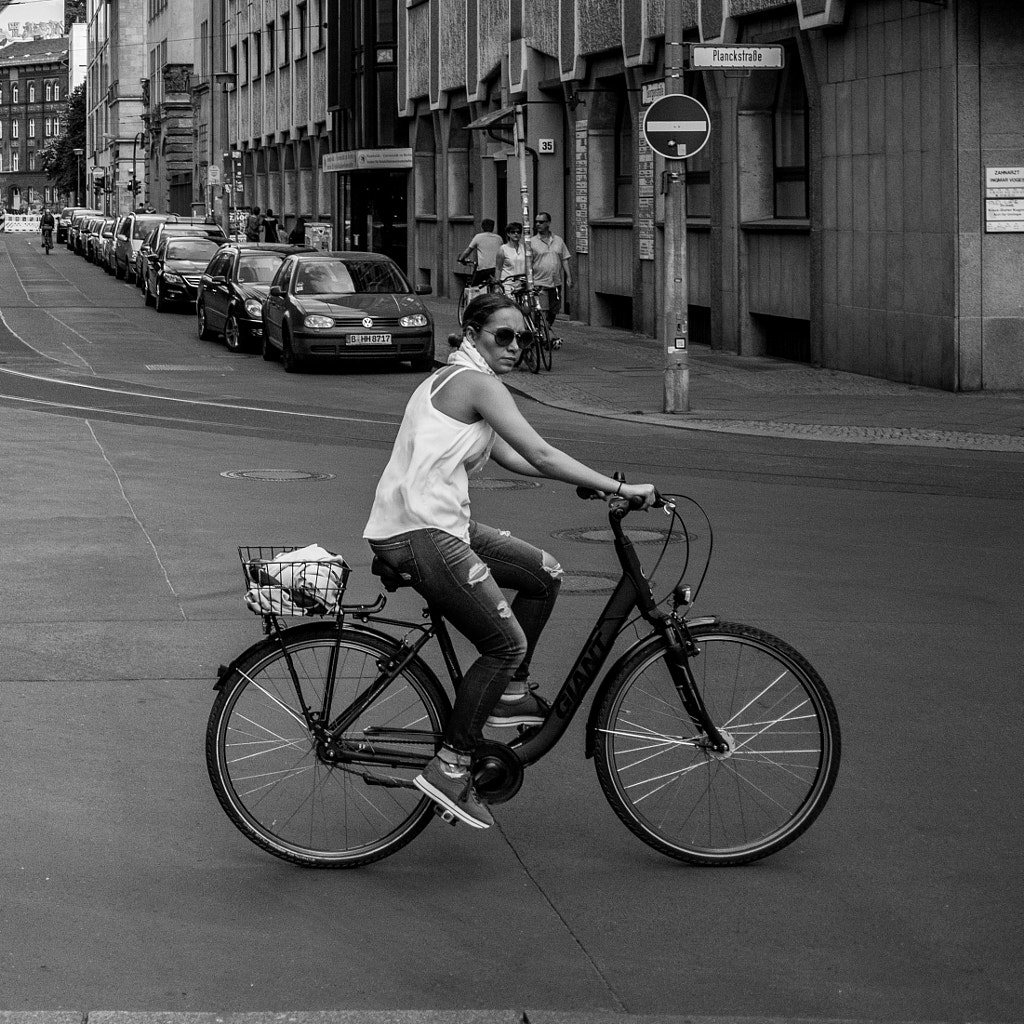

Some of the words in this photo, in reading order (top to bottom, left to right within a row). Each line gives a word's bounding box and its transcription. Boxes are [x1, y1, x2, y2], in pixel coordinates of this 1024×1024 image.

[712, 49, 763, 62] Planckstraße
[542, 141, 552, 151] 35
[554, 631, 609, 720] GIANT
